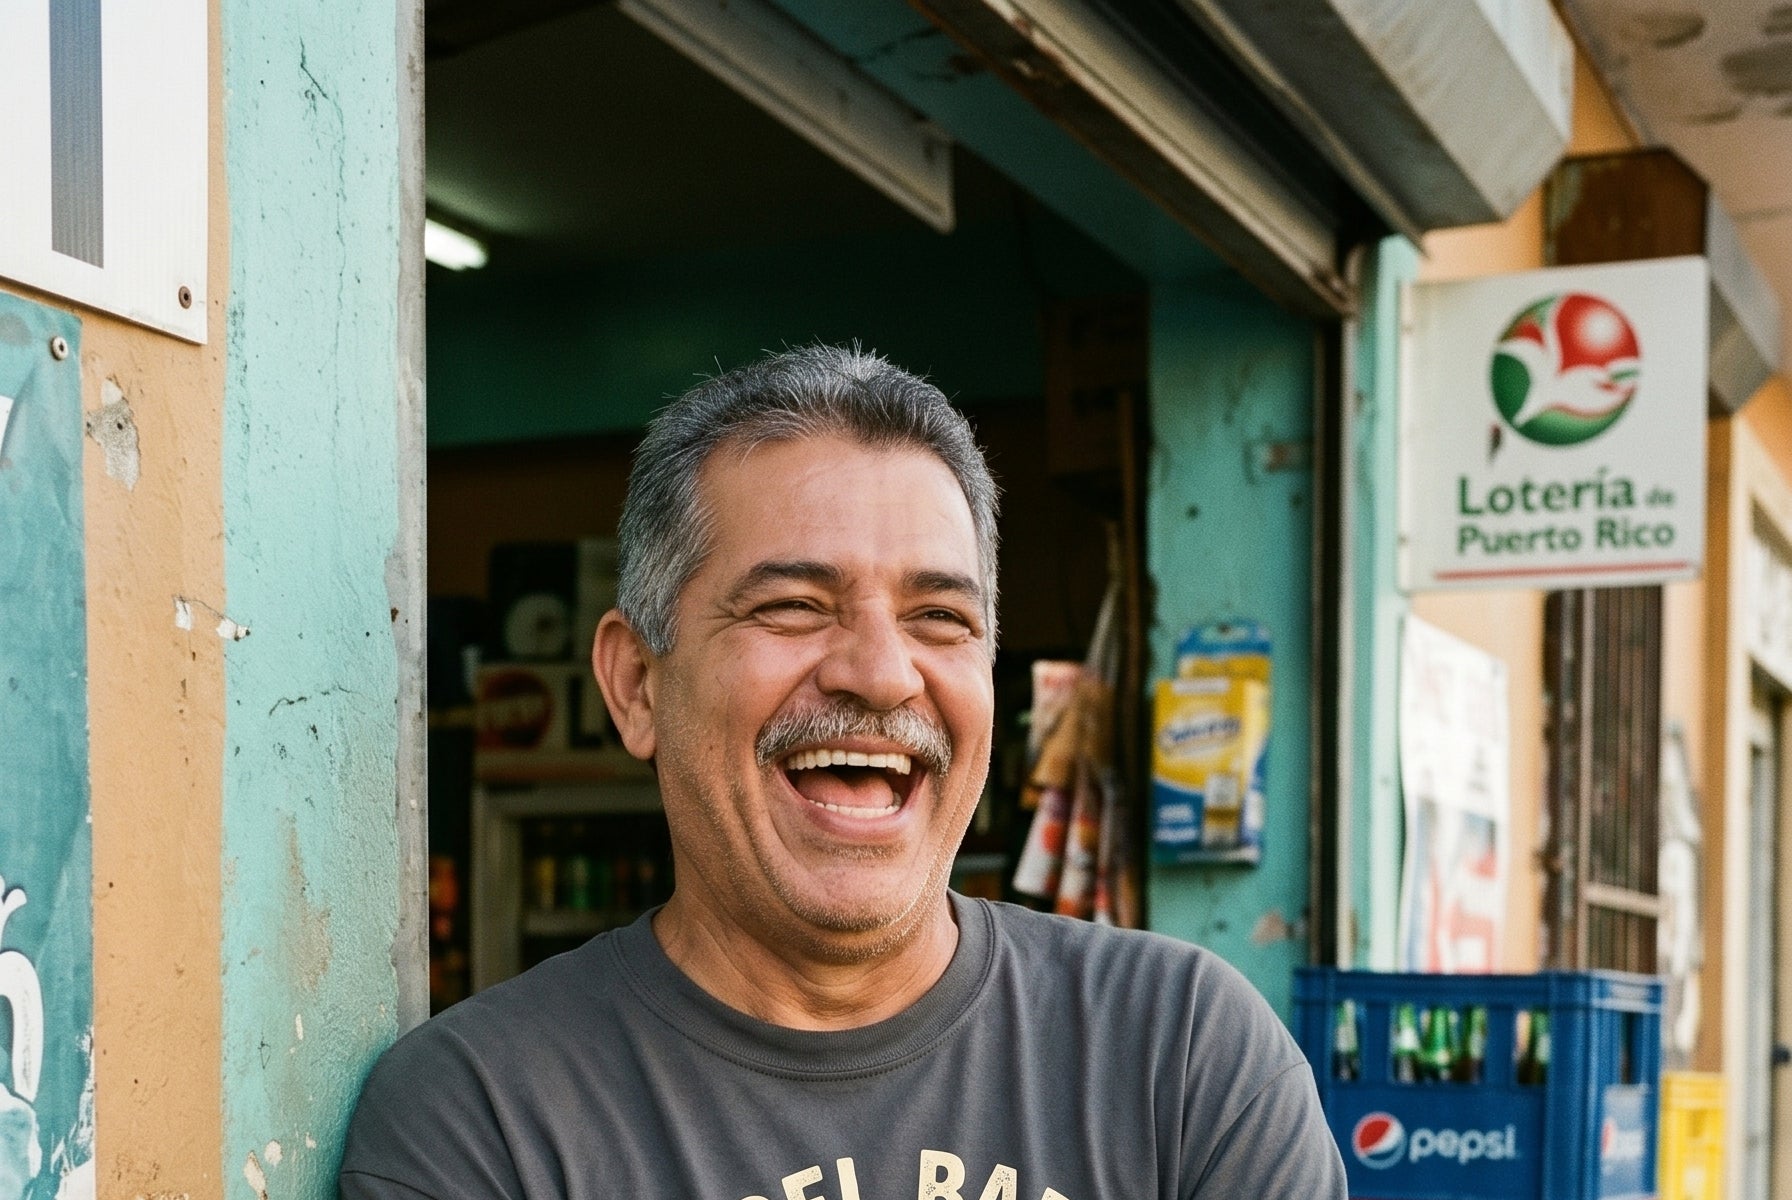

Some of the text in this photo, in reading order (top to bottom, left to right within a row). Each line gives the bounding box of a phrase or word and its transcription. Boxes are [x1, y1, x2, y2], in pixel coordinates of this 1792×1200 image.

[1457, 466, 1634, 515] Lotería
[1457, 517, 1675, 555] Puerto Rico
[1408, 1123, 1516, 1165] pepsi
